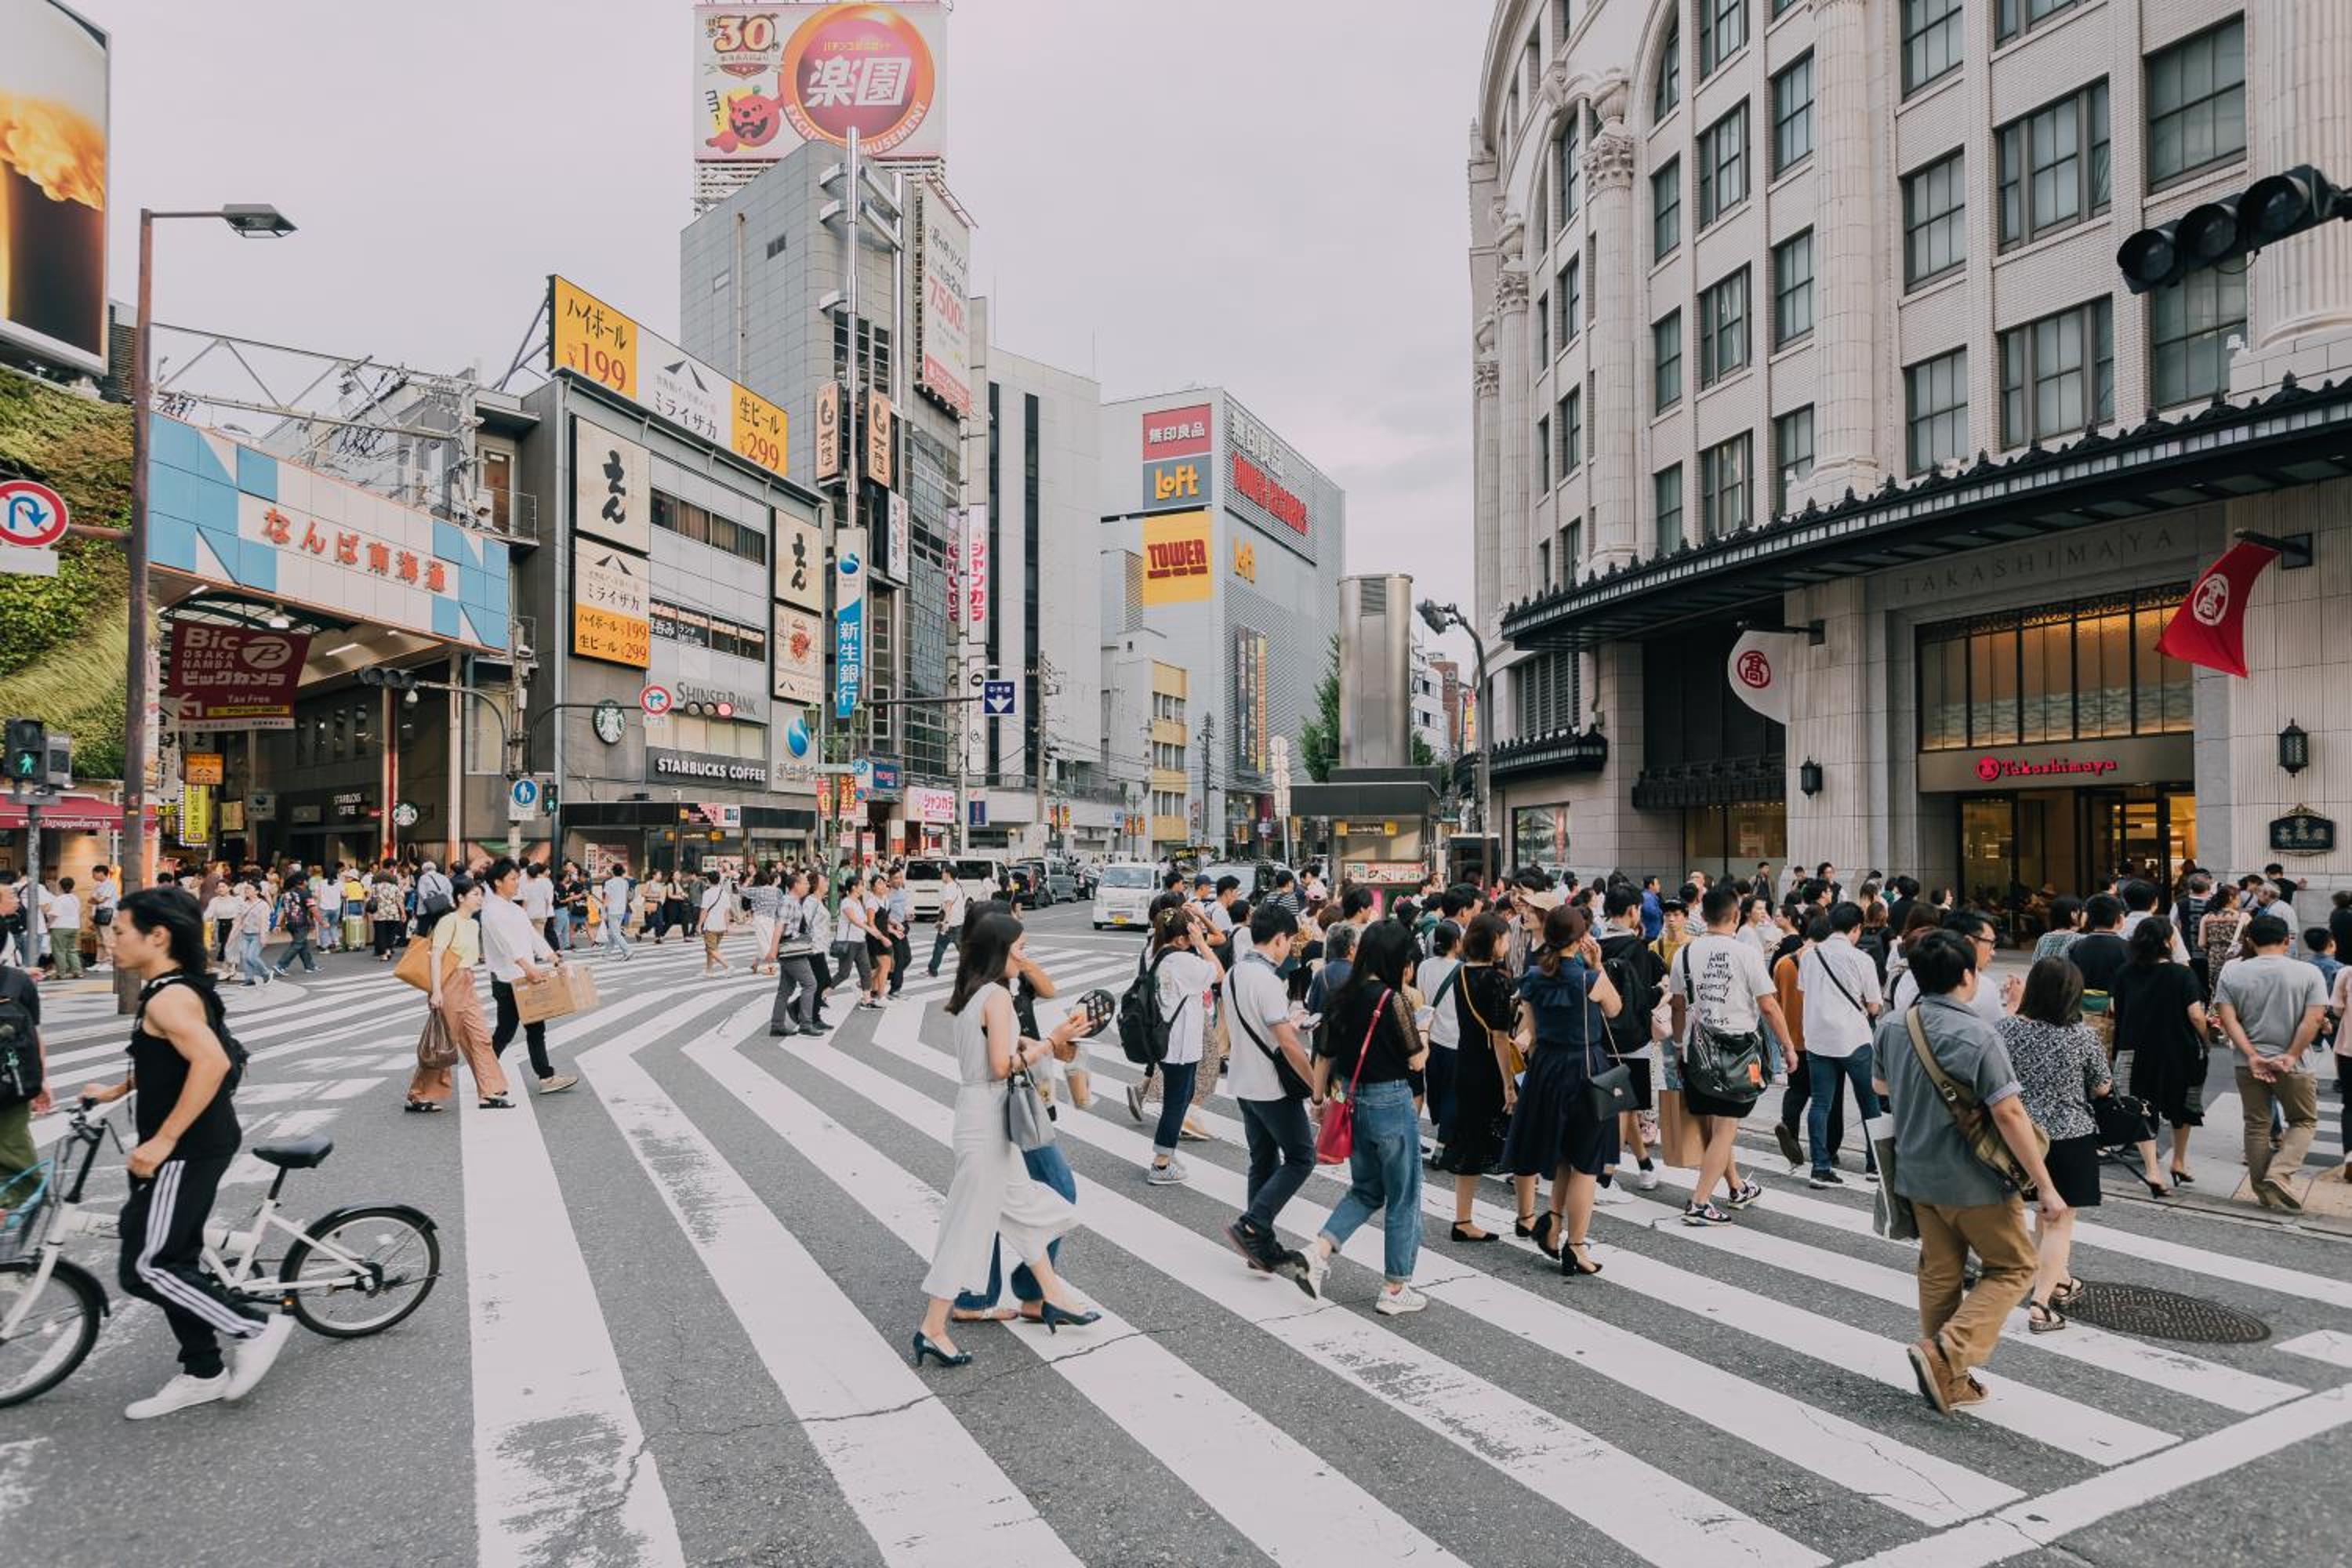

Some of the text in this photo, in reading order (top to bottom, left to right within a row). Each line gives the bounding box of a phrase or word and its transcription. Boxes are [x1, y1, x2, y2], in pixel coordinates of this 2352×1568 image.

[804, 55, 912, 107] 楽園
[859, 100, 927, 156] MUSEMENT
[567, 298, 626, 350] ハイボール
[655, 391, 717, 440] ミライサカ
[739, 396, 779, 435] 生ビール
[1149, 422, 1205, 445] 無印良品
[261, 507, 445, 593] なんば南海通
[1147, 539, 1207, 569] TOWER
[1903, 527, 2173, 595] TAKASHIMAYA
[588, 583, 640, 612] ミライサカ
[184, 627, 241, 650] Bic
[579, 633, 617, 652] 生ビール
[181, 659, 234, 670] NAMBA
[183, 650, 235, 660] OSAKA
[840, 621, 859, 706] 新生銀行
[181, 671, 287, 687] ビックカメラ
[728, 691, 757, 715] BANK
[657, 757, 727, 778] STARBUCKS
[728, 764, 766, 782] COFFEE
[2002, 757, 2117, 777] Takashimaya
